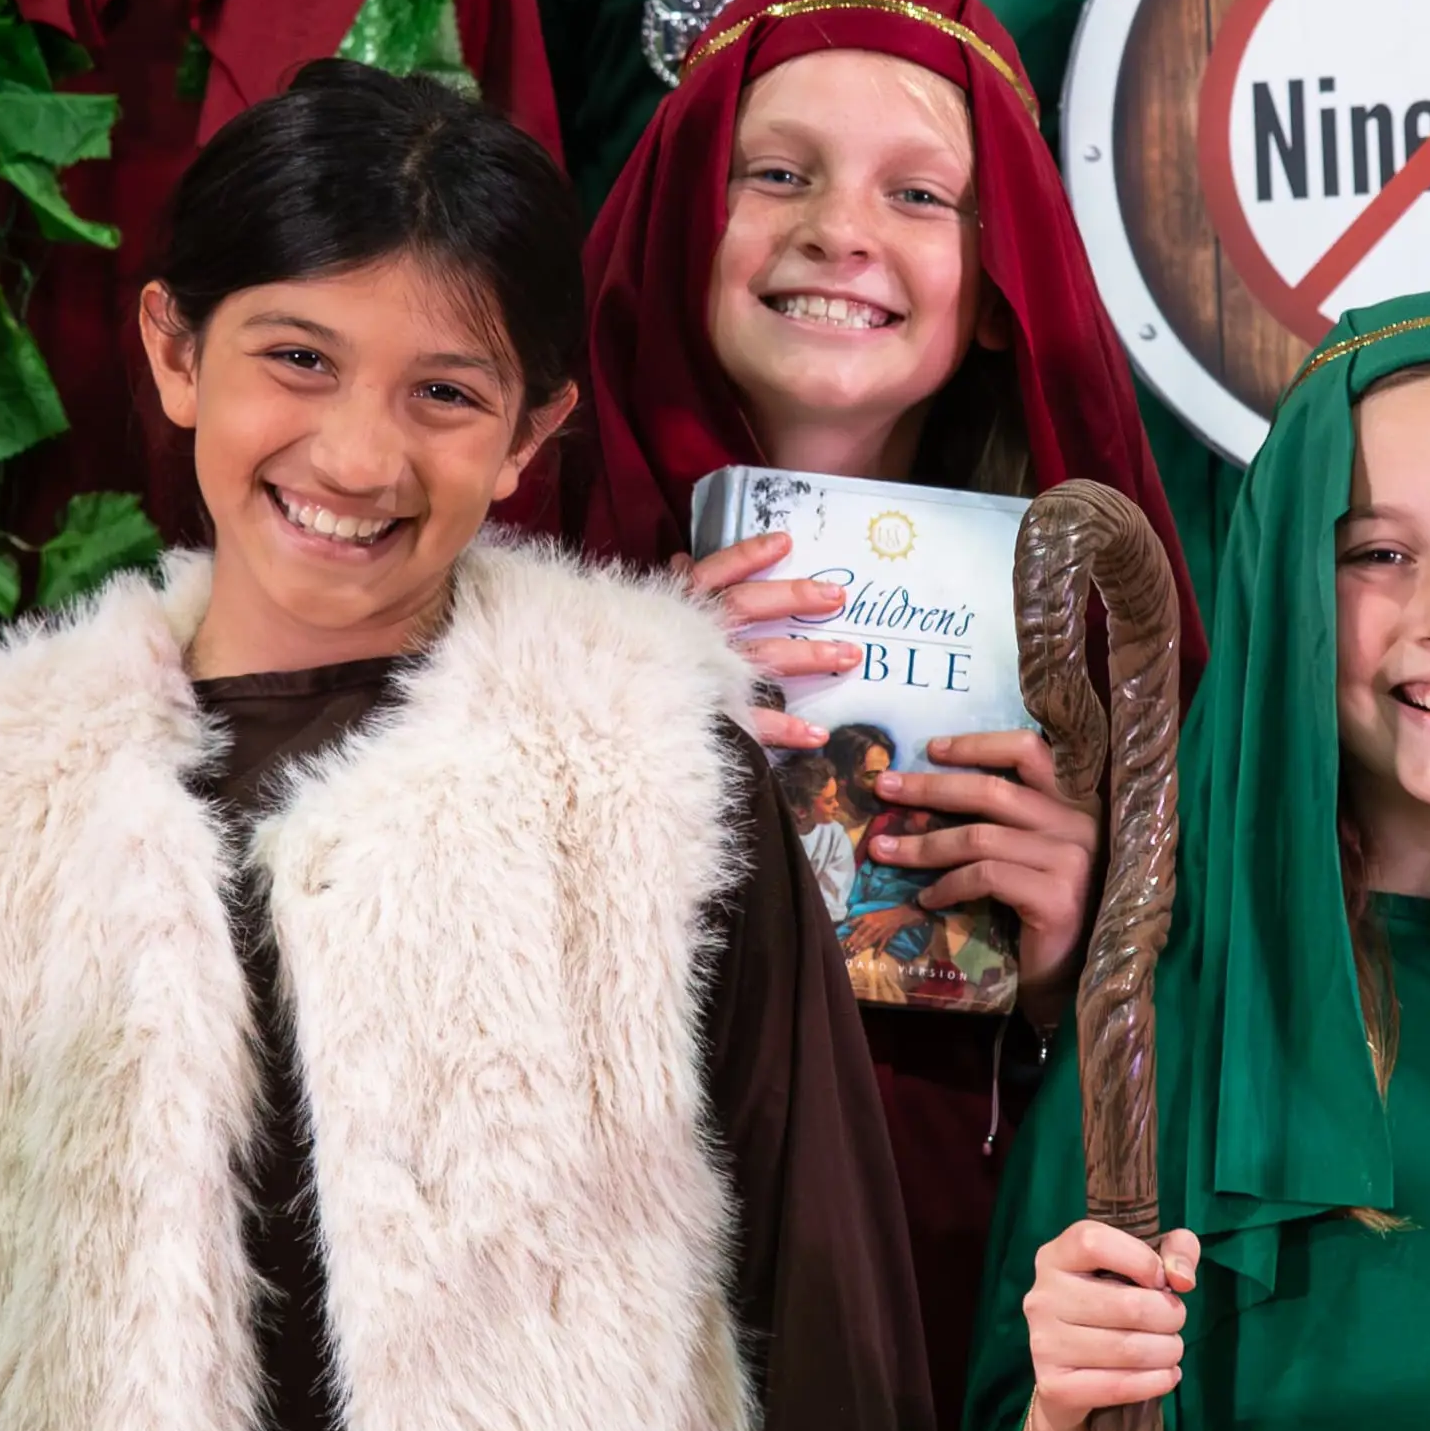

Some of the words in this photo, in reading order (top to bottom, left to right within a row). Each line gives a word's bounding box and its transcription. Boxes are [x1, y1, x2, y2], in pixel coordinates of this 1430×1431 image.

[789, 567, 975, 638] Children's
[786, 633, 972, 693] BLE
[898, 964, 969, 982] VERSION
